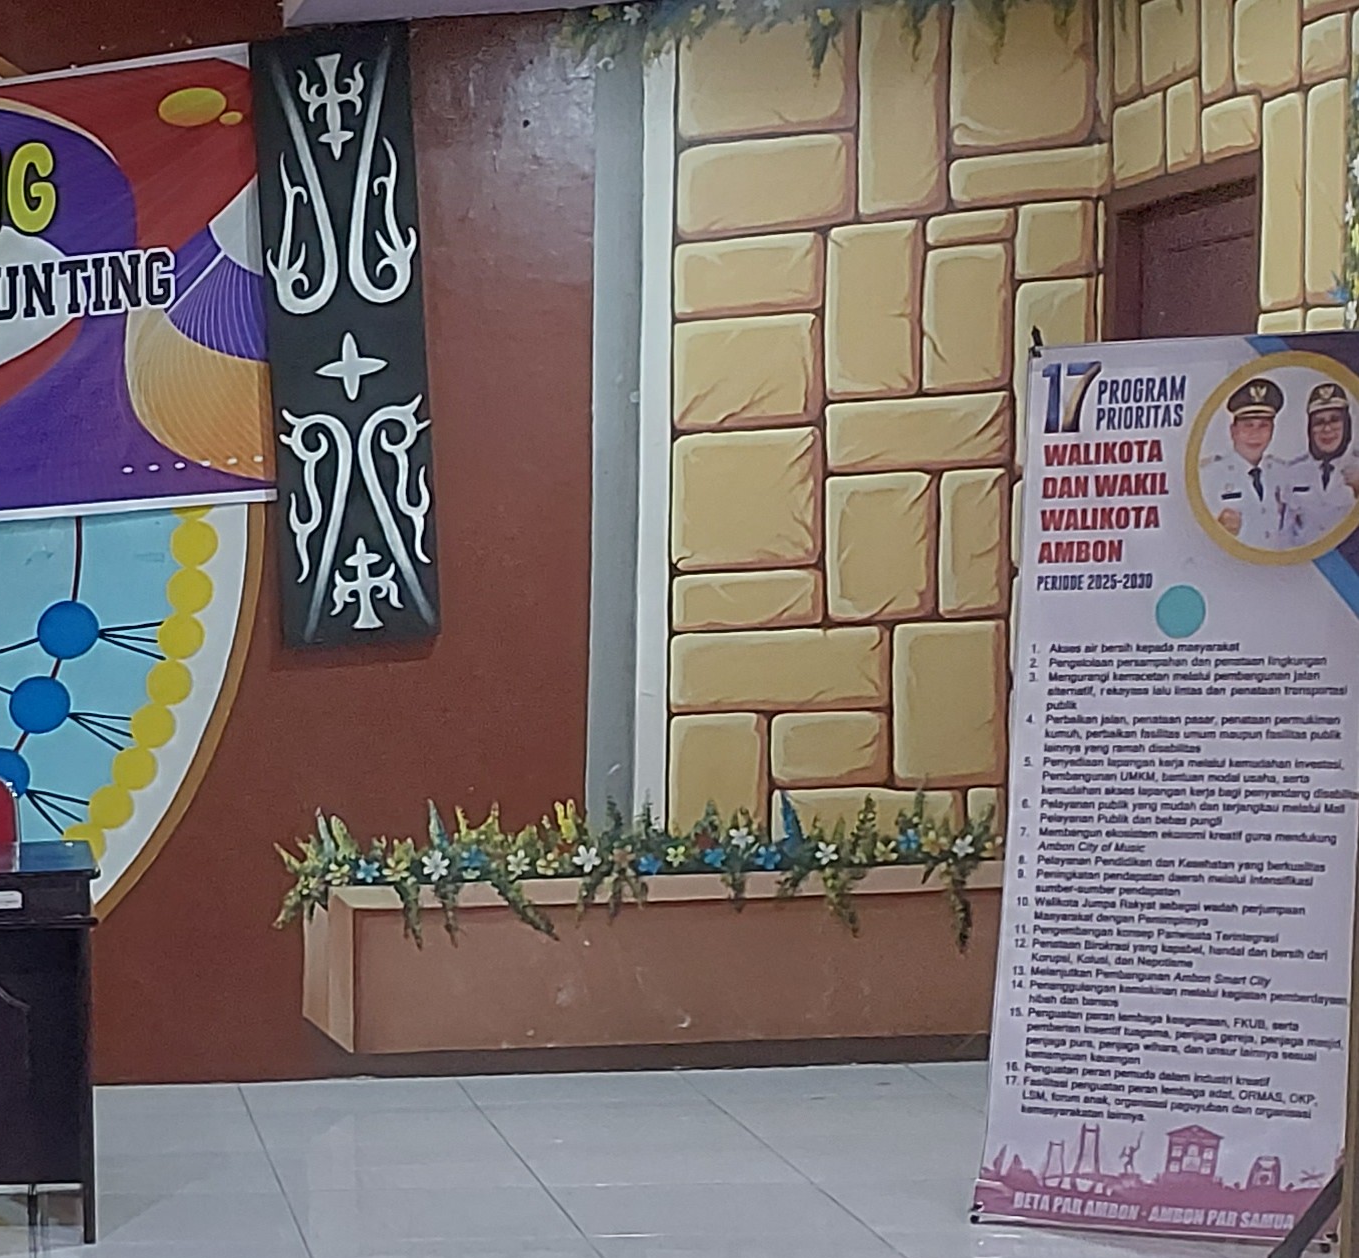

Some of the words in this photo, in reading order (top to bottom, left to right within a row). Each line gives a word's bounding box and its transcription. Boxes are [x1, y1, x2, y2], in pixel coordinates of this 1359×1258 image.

[1042, 361, 1102, 433] 17
[1097, 375, 1186, 405] PROGRAM
[1095, 403, 1184, 431] PRIORITAS
[1043, 440, 1163, 467] WALIKOTA
[1041, 475, 1090, 500] DAN
[1094, 472, 1169, 497] WAKIL
[1040, 506, 1160, 532] WALIKOTA
[1038, 540, 1123, 564] AMBON
[1037, 575, 1084, 591] PERIODE
[1087, 573, 1153, 590] 2025-2030
